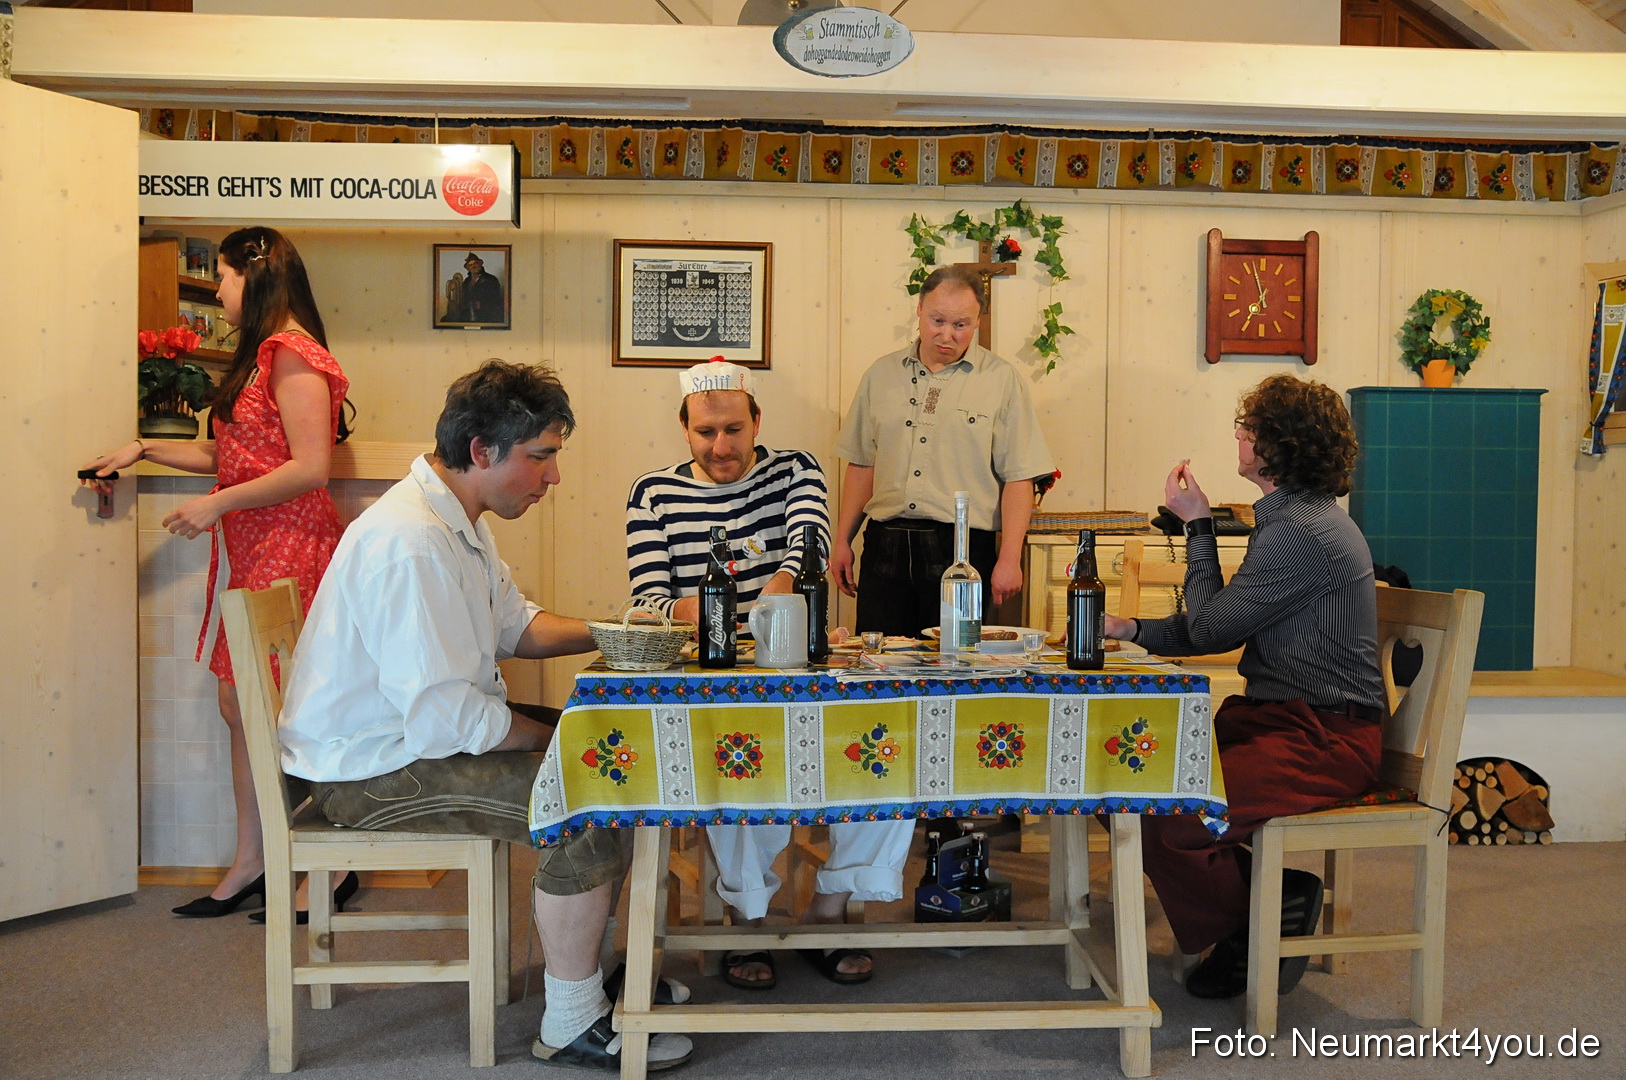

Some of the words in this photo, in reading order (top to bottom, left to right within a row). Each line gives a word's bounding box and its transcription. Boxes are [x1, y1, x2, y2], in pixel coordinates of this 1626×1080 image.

[819, 16, 880, 39] Stammtisch
[139, 175, 209, 196] BESSER
[217, 176, 282, 198] GEHT'S
[290, 178, 324, 198] MIT
[330, 177, 437, 199] COCA-COLA
[445, 176, 494, 194] Coca-Cola
[457, 195, 484, 207] Coke
[692, 374, 731, 393] Schiff
[708, 599, 727, 650] Landbier
